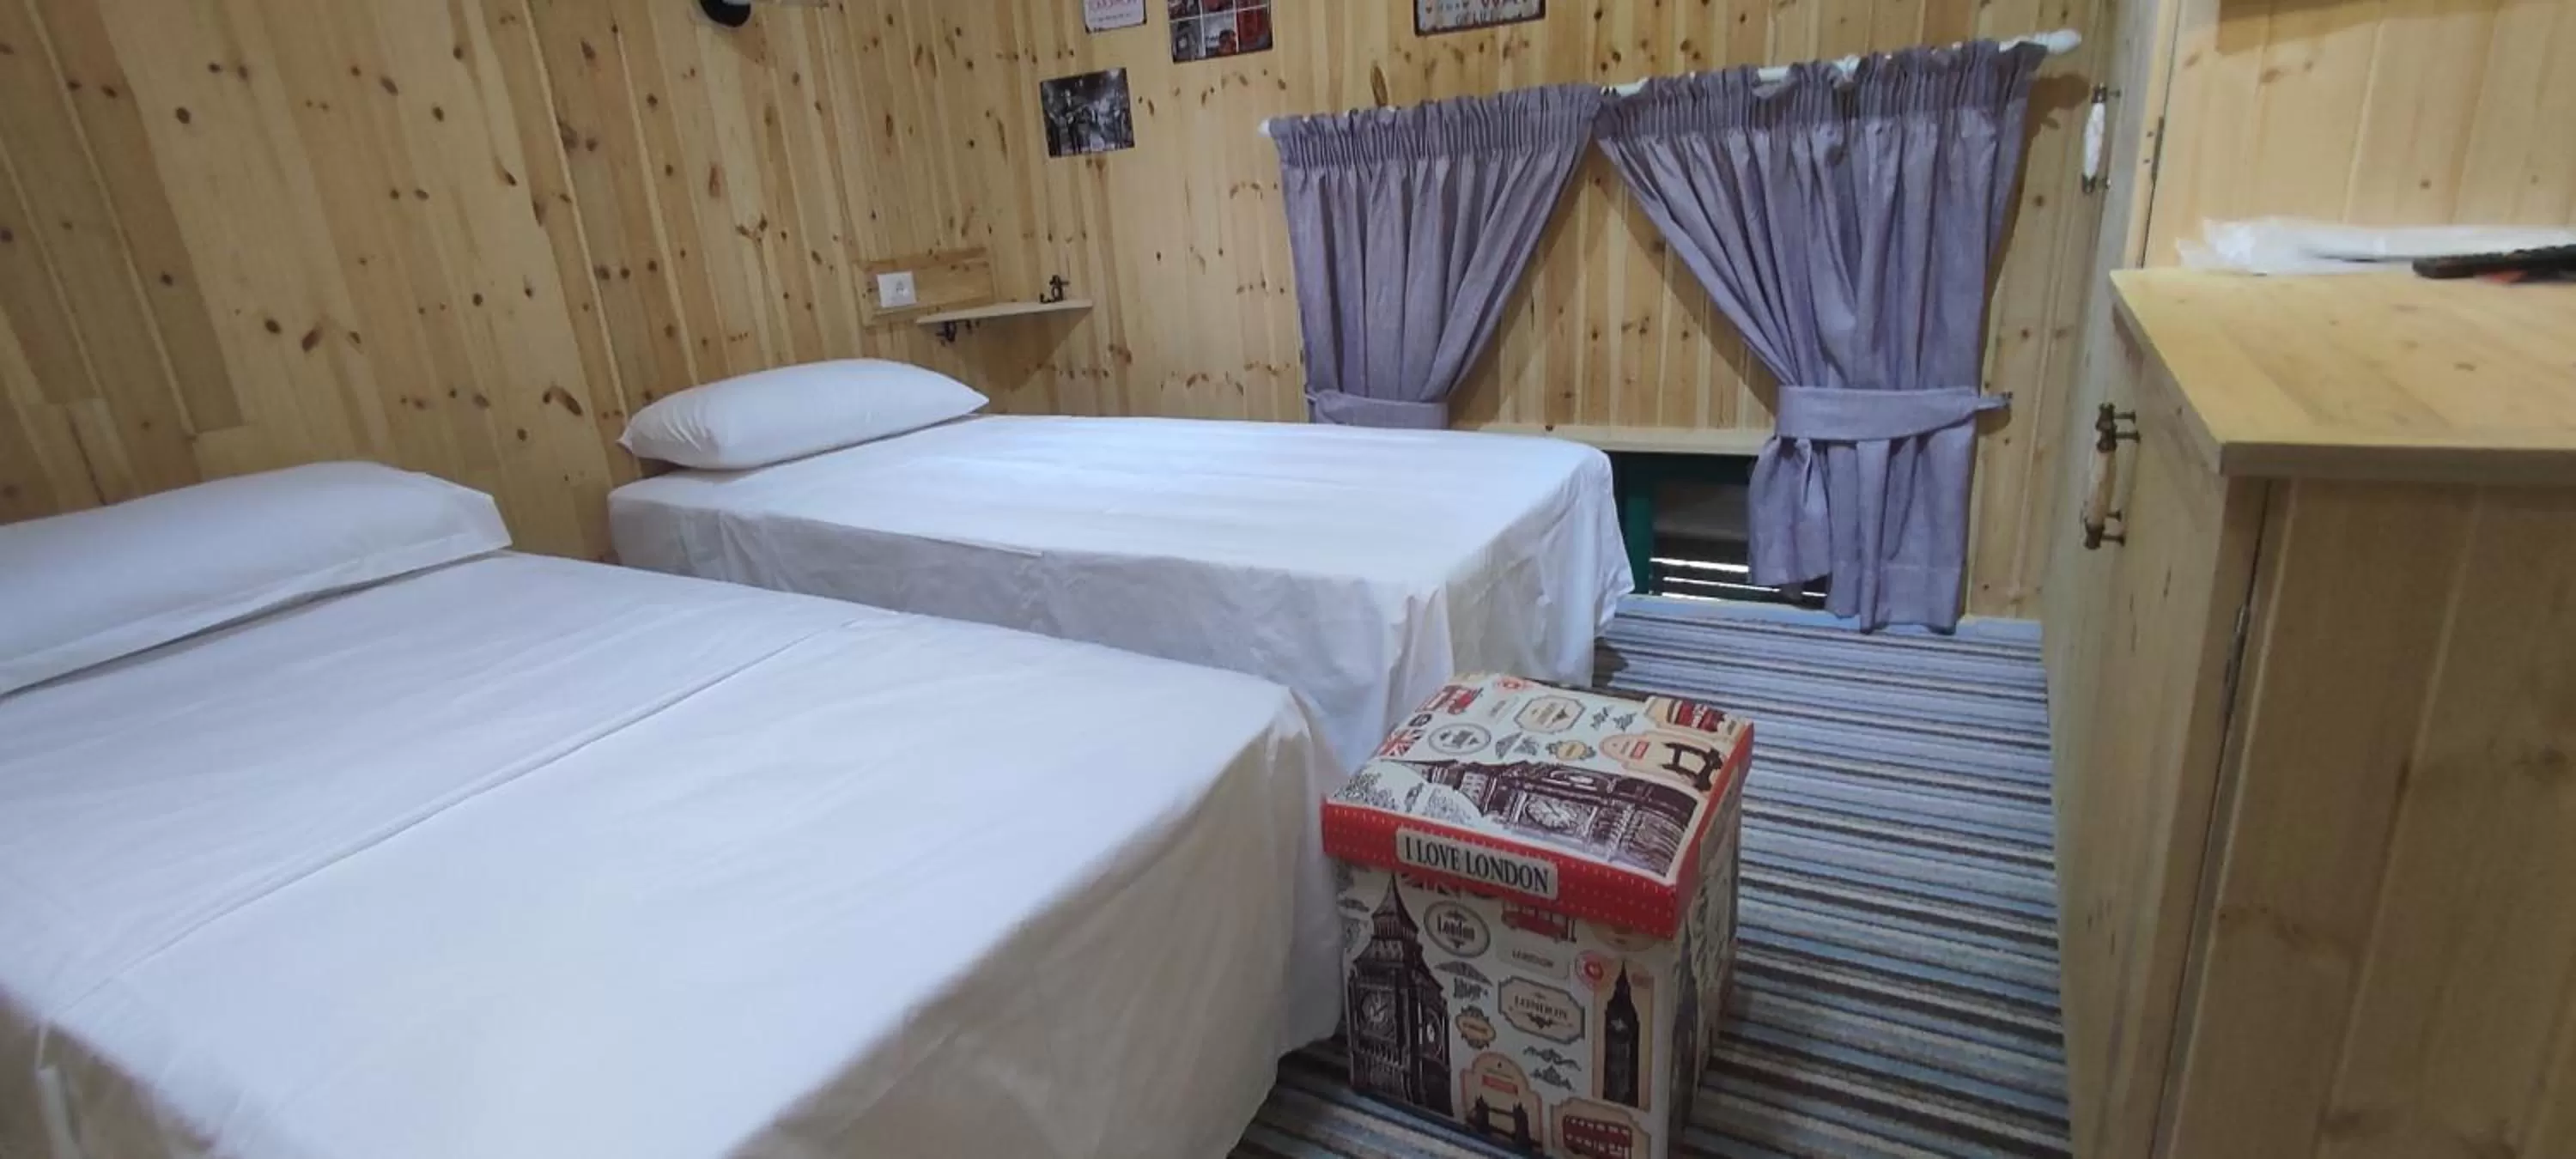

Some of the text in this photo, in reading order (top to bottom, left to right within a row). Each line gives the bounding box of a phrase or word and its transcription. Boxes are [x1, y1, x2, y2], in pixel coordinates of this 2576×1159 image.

[1405, 836, 1549, 895] I LOVE LONDON
